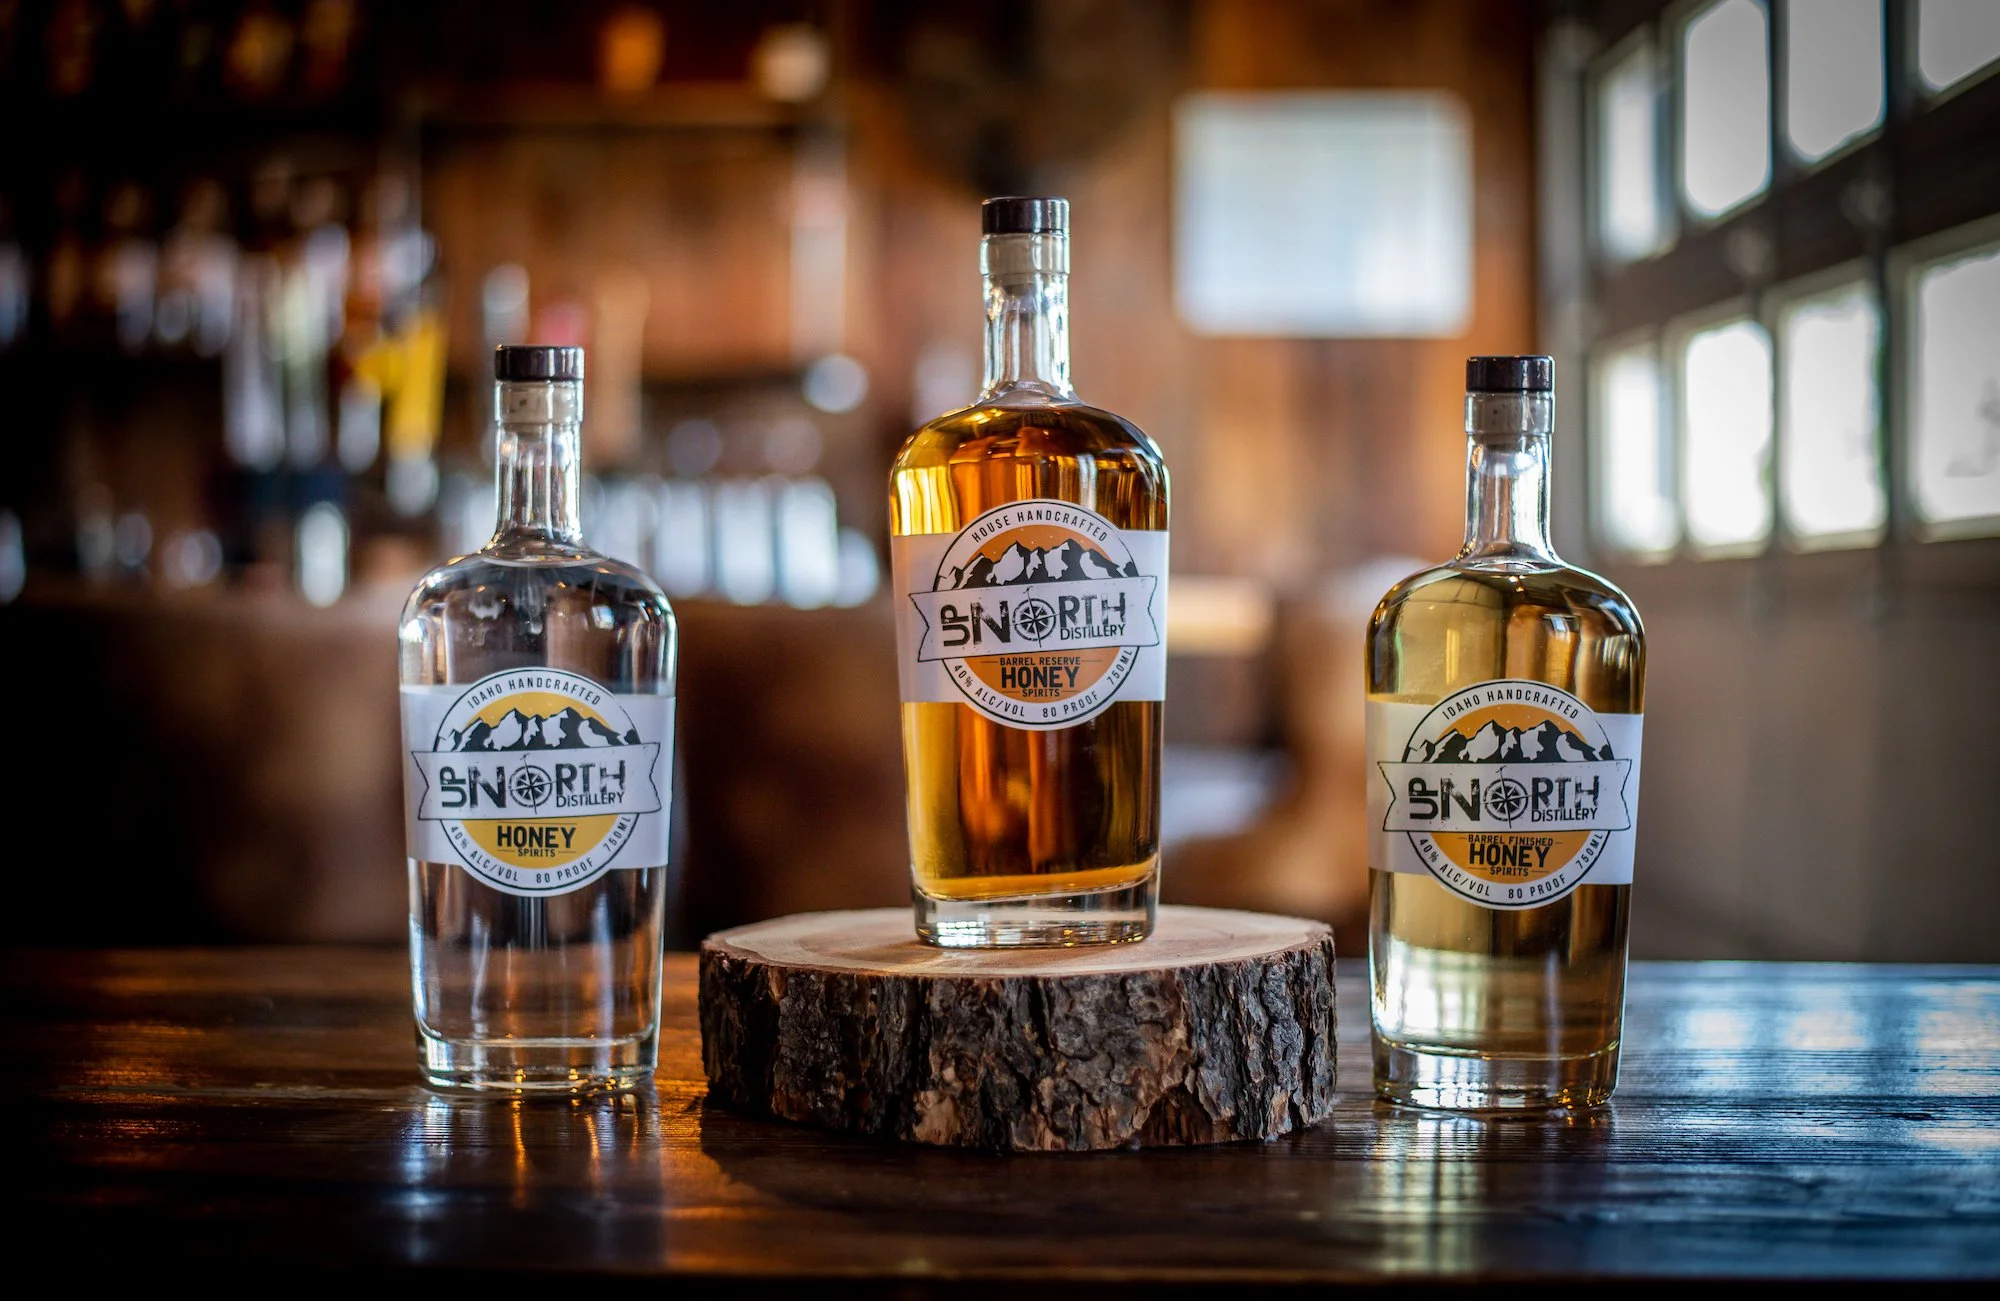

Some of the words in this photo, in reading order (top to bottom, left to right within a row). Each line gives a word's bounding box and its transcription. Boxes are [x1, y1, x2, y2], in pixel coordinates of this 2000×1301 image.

[972, 516, 1011, 543] HOUSE
[1017, 510, 1108, 542] HANDCRAFTED
[940, 604, 970, 647] UP
[1000, 657, 1036, 665] BARREL
[1039, 657, 1081, 665] RESERVE
[954, 665, 973, 688] 40%
[975, 688, 1025, 717] ALC/VOL
[1043, 707, 1056, 718] 80
[1063, 691, 1098, 715] PROOF
[1106, 650, 1132, 686] 750ML
[1001, 666, 1080, 688] HONEY
[1022, 688, 1060, 697] SPIRITS
[467, 683, 503, 709] IDAHO
[509, 678, 601, 705] HANDCRAFTED
[1442, 695, 1481, 720] IDAHO
[1487, 689, 1579, 719] HANDCRAFTED
[439, 766, 467, 808] UP
[1408, 777, 1439, 820] UP
[451, 826, 469, 850] 40%
[470, 850, 519, 882] ALC/VOL
[536, 874, 550, 883] 80
[557, 857, 593, 880] PROOF
[603, 816, 631, 852] 750ML
[497, 826, 577, 849] HONEY
[518, 848, 556, 857] SPIRITS
[1468, 834, 1505, 845] BARREL
[1508, 835, 1553, 846] FINISHED
[1419, 838, 1439, 863] 40%
[1439, 863, 1490, 896] ALC/VOL
[1508, 888, 1523, 899] 80
[1530, 874, 1566, 896] PROOF
[1575, 833, 1603, 869] 750ML
[1469, 843, 1552, 868] HONEY
[1490, 866, 1529, 876] SPIRITS
